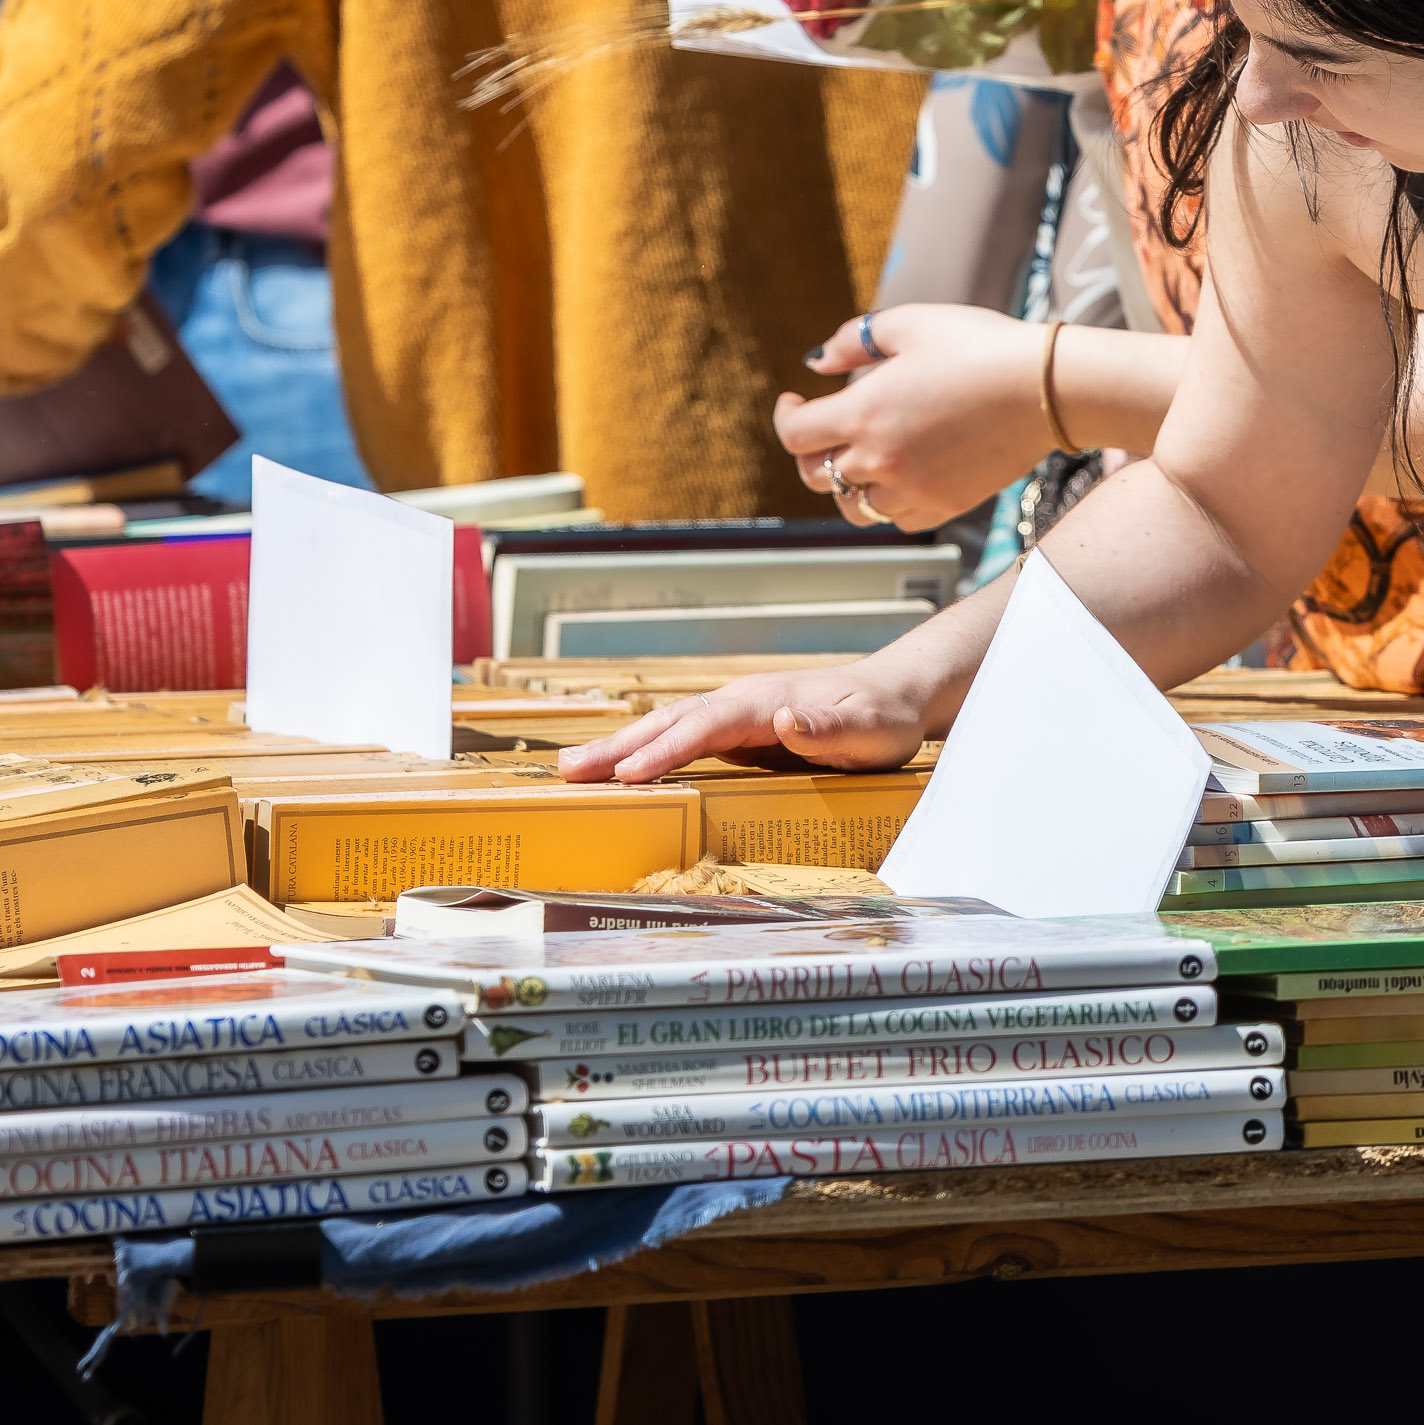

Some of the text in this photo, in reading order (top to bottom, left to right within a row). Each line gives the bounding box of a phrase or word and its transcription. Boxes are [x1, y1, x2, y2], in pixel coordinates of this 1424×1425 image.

[1293, 774, 1306, 787] 13
[1229, 802, 1238, 818] 22
[288, 823, 298, 874] CATALANA
[391, 837, 399, 861] (1936)
[466, 836, 475, 863] pàgines
[766, 820, 774, 860] Catalunya
[1226, 851, 1237, 863] 15
[725, 955, 1200, 1004] PARRILLA CLASICA 5
[428, 1007, 446, 1026] 6
[616, 998, 1195, 1047] EL GRAN LIBRO DE LA COCINA VEGETARIANA 4
[97, 1055, 265, 1103] FRANCESA
[745, 1031, 1266, 1087] BUFFET FRIO CLASICO 3
[156, 1106, 272, 1143] HIERBAS
[768, 1091, 880, 1131] COCINA
[893, 1078, 1116, 1124] MEDITERRANEA
[1252, 1077, 1270, 1098] 2
[158, 1135, 341, 1185] ITALIANA
[488, 1130, 505, 1149] 7
[722, 1132, 894, 1180] PASTA
[1246, 1121, 1262, 1141] 1
[32, 1192, 167, 1240] COCINA
[489, 1172, 506, 1192] 6
